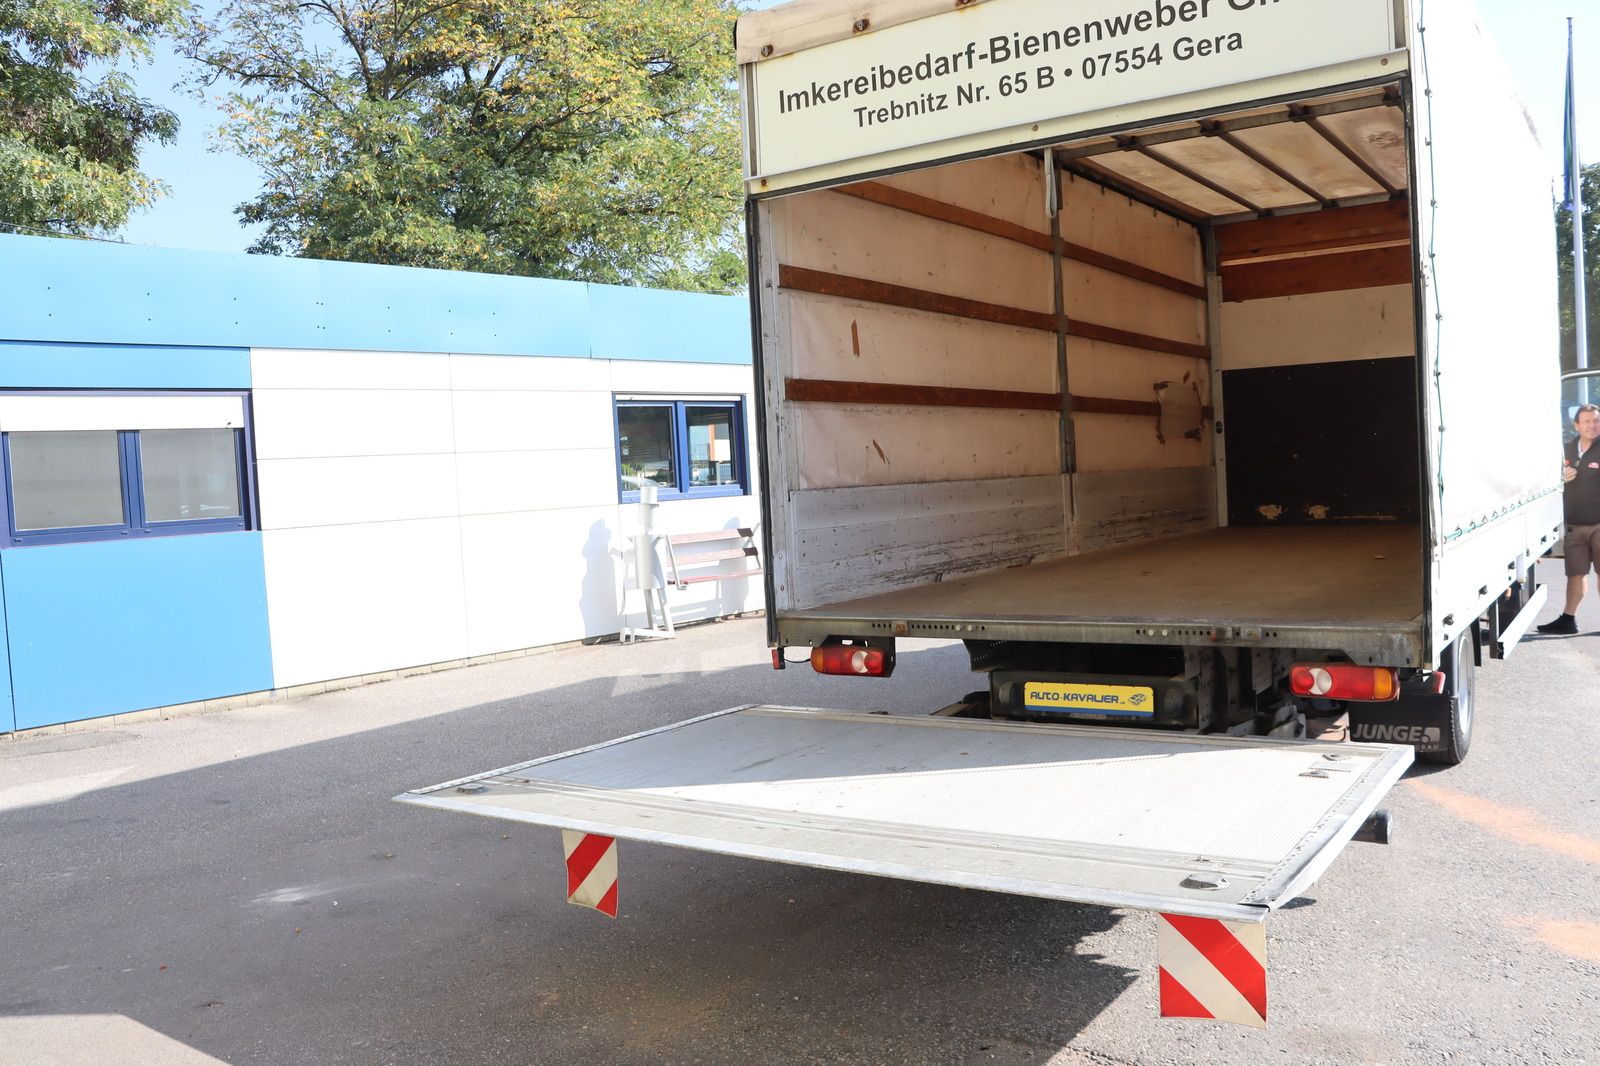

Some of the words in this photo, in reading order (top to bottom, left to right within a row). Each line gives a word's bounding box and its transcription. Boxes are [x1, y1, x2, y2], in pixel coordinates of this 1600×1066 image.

[779, 0, 1210, 114] Imkereibedarf-Bienenweber
[854, 91, 949, 129] Trebnitz
[956, 82, 990, 105] Nr.
[999, 74, 1028, 97] 65
[1037, 66, 1055, 90] B
[1081, 42, 1163, 80] 07554
[1173, 32, 1243, 61] Gera
